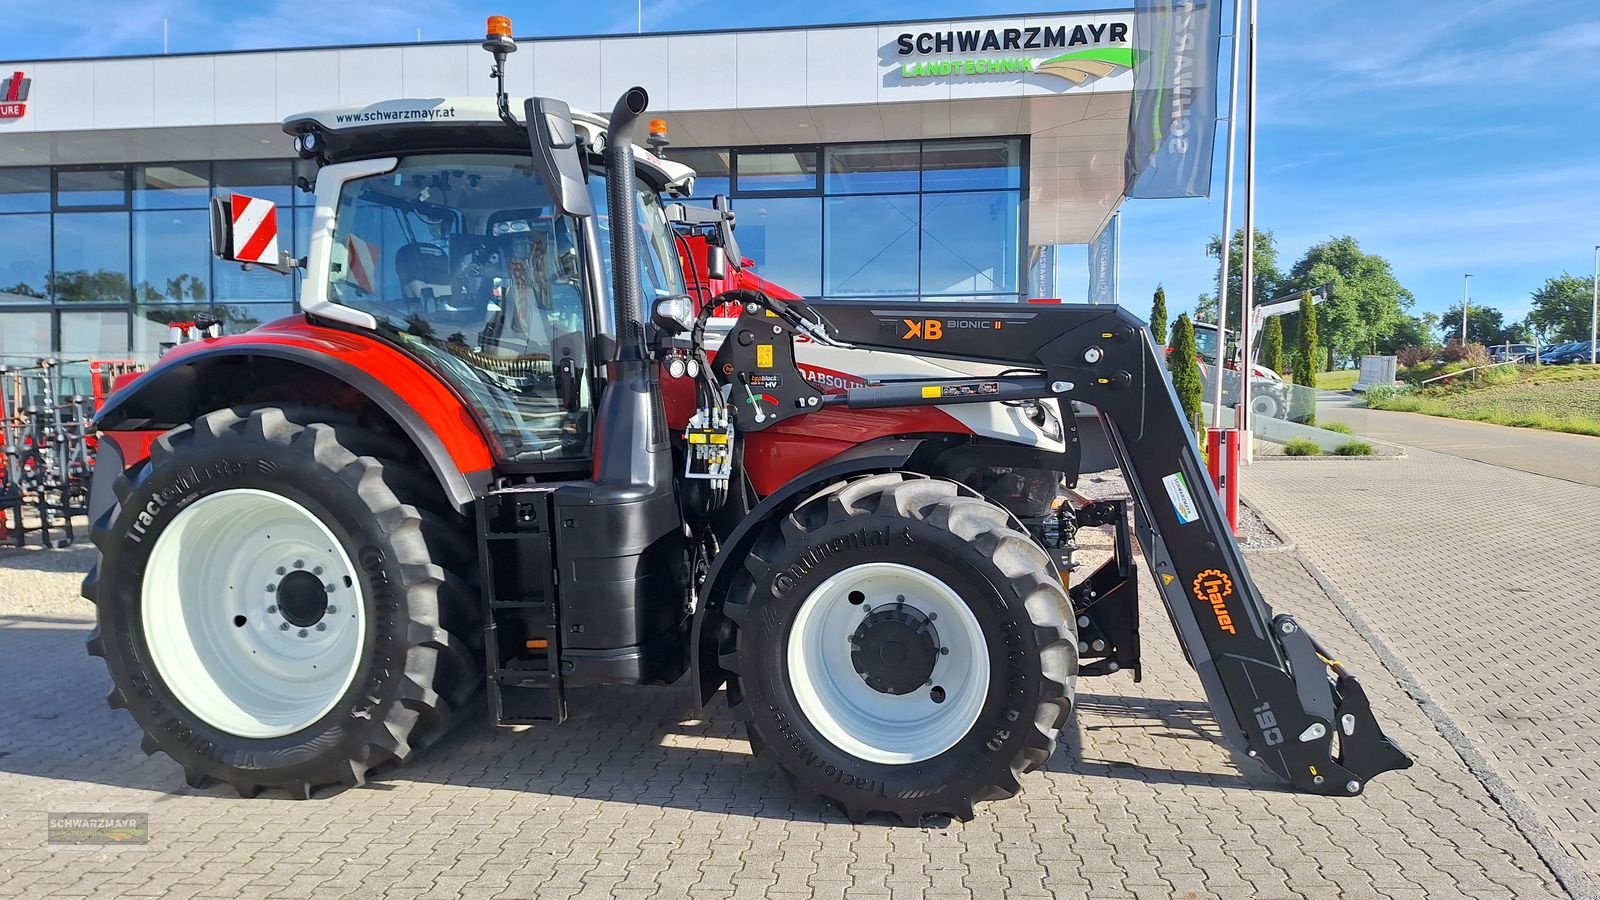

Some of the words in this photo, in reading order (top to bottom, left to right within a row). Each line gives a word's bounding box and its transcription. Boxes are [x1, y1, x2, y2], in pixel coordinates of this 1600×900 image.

[897, 22, 1128, 56] SCHWARZMAYR
[901, 57, 1034, 78] LANDTECHNIK
[0, 105, 19, 115] URE
[336, 106, 455, 123] www.schwarzmayr.at
[947, 320, 991, 329] BIONIC
[1203, 579, 1238, 635] hauer
[1252, 701, 1286, 748] 190
